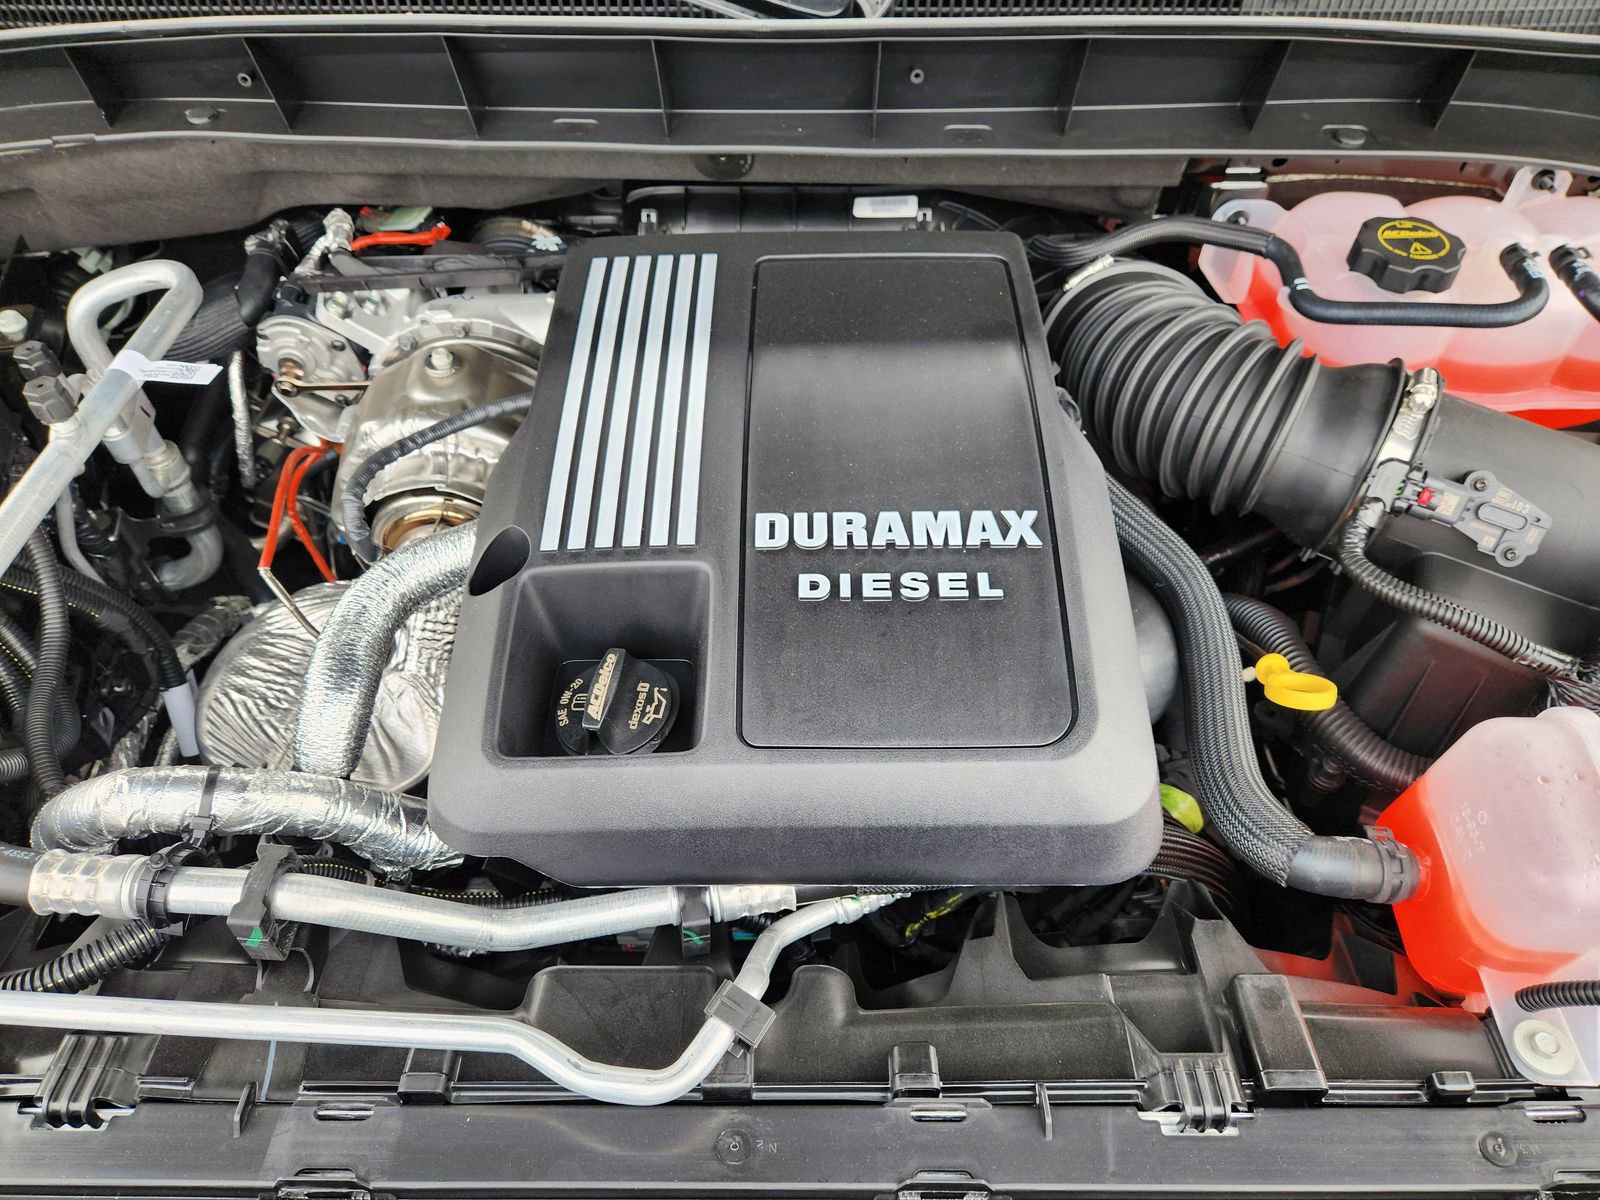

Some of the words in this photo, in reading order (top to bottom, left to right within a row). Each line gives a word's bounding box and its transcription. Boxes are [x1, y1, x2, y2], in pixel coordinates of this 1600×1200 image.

[754, 510, 1043, 550] DURAMAX
[798, 572, 1004, 601] DIESEL
[587, 653, 617, 721] ACDelco
[628, 682, 650, 730] dexosD
[558, 708, 569, 727] SAE
